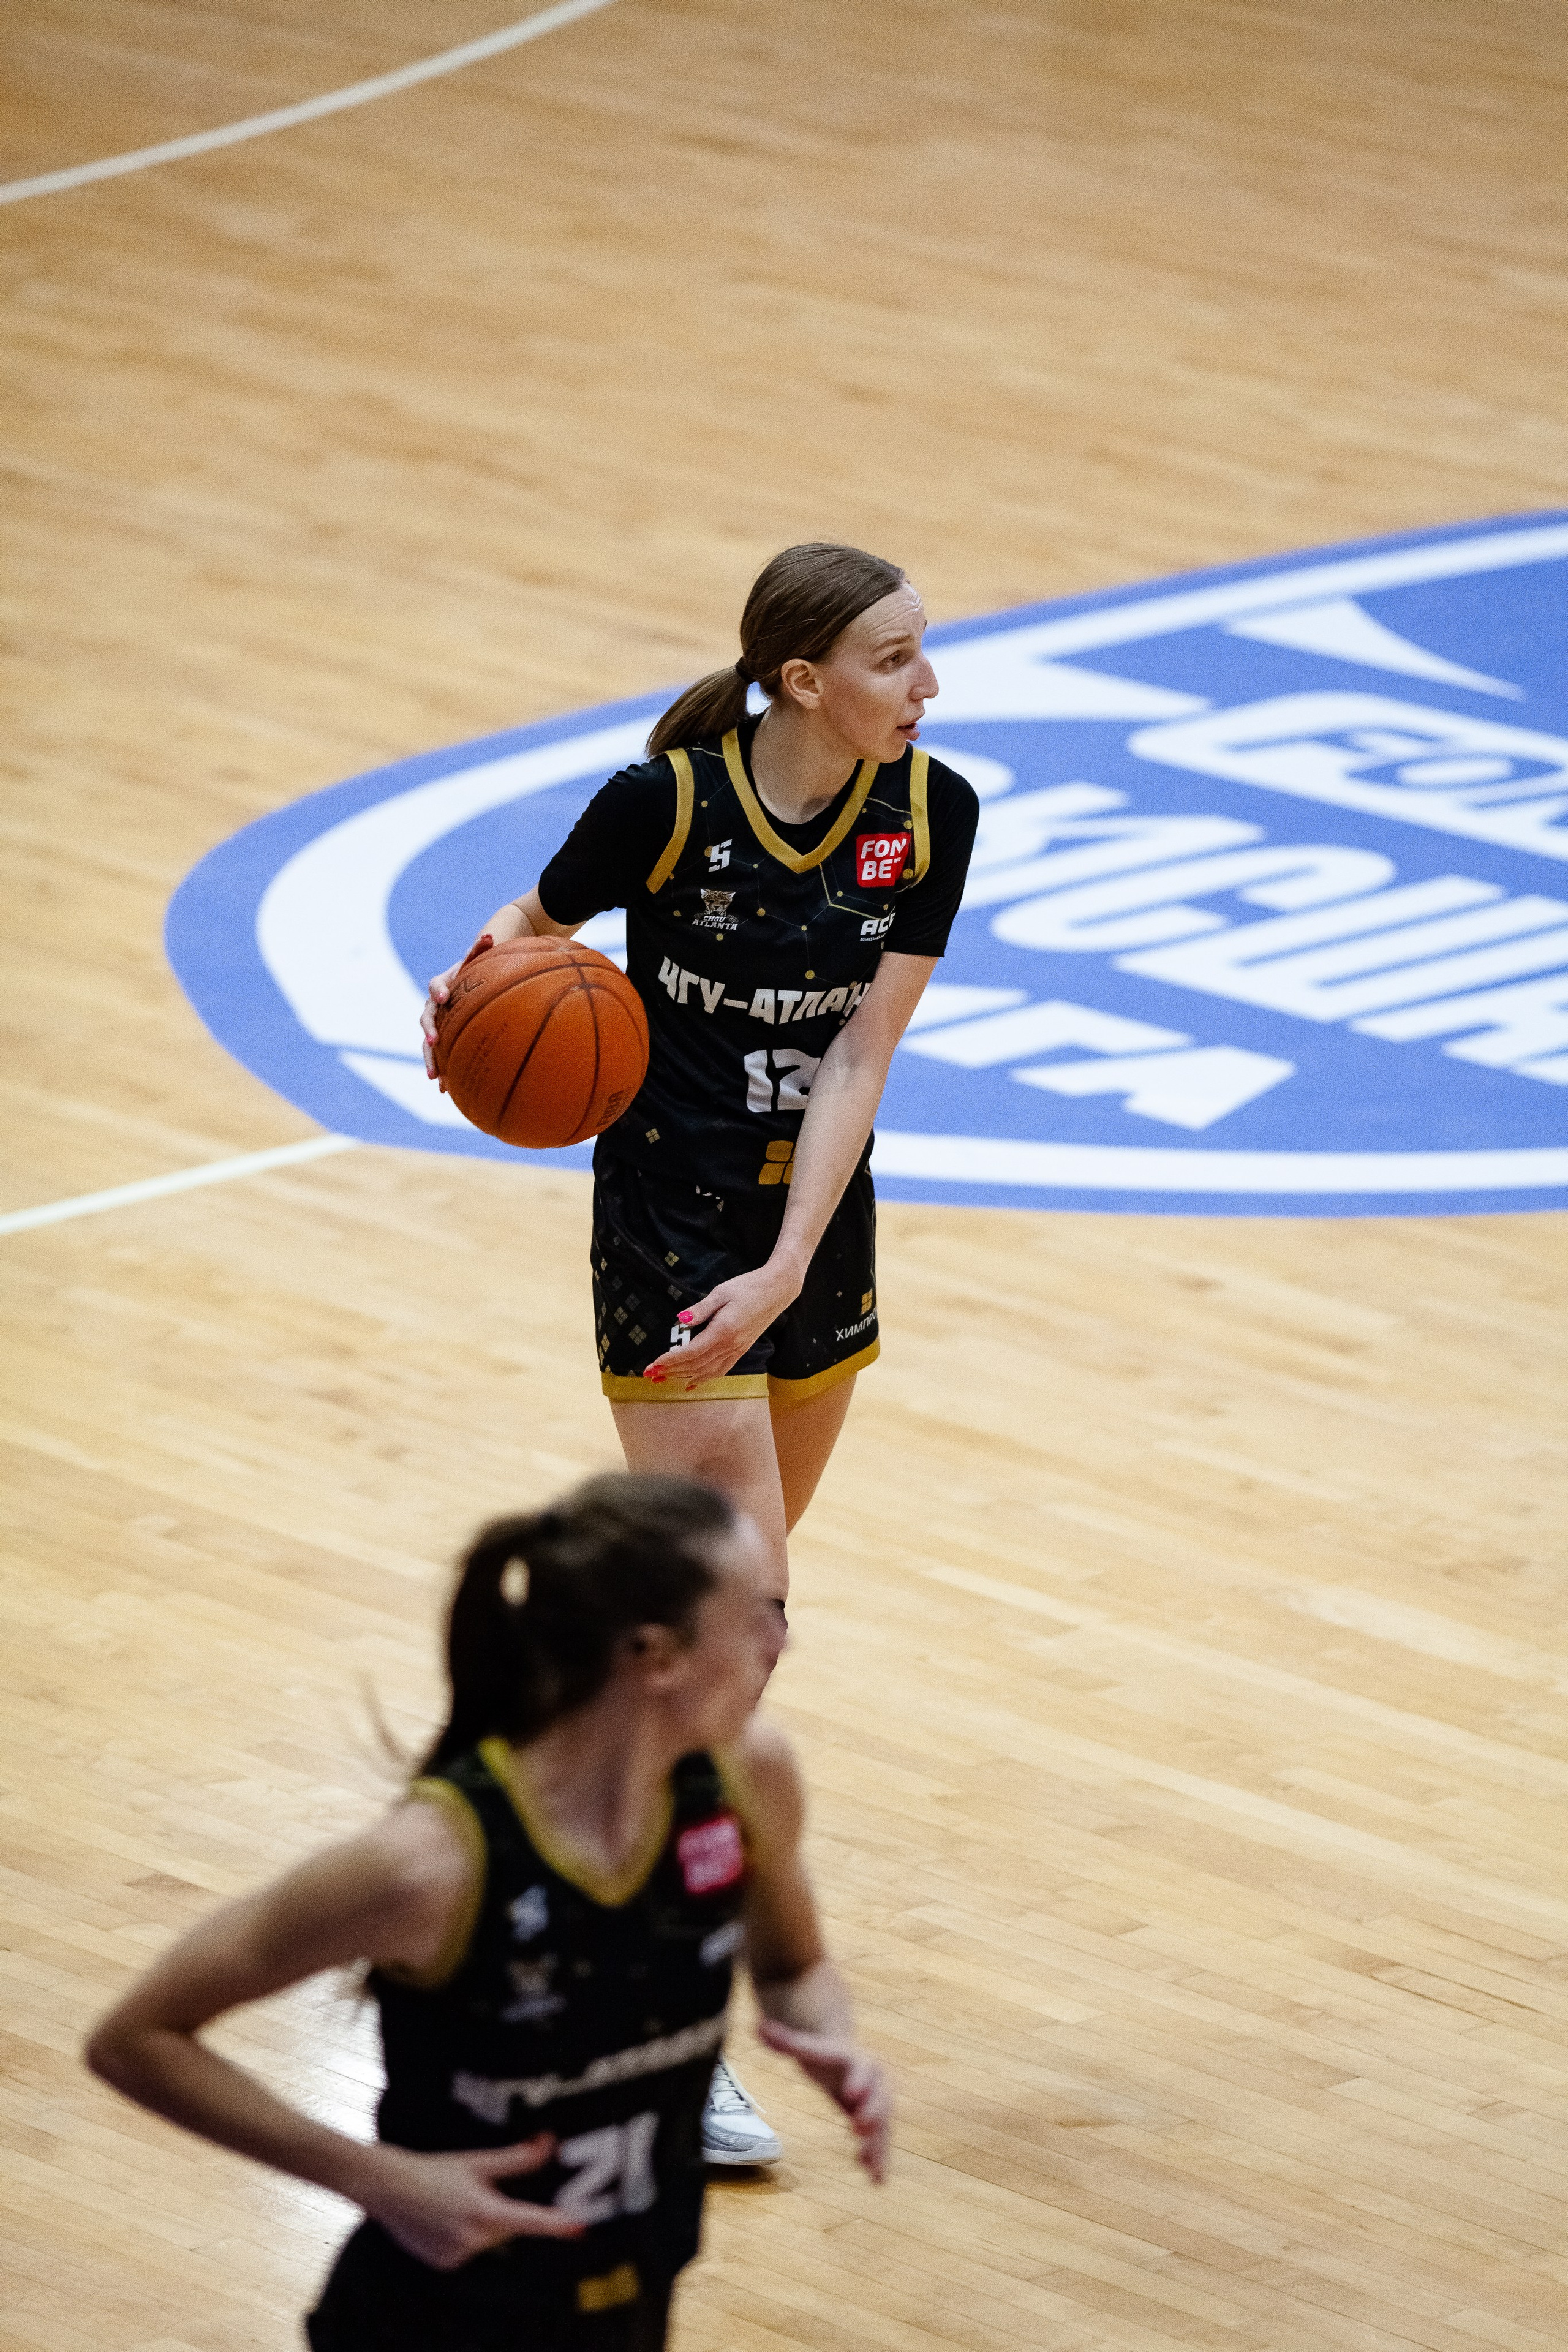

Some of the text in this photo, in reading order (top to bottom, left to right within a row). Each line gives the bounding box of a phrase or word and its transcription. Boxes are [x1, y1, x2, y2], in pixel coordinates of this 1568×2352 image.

[860, 837, 908, 859] FON
[691, 918, 739, 931] ATLANTA
[744, 1048, 821, 1113] 12
[553, 2109, 660, 2227] 21
